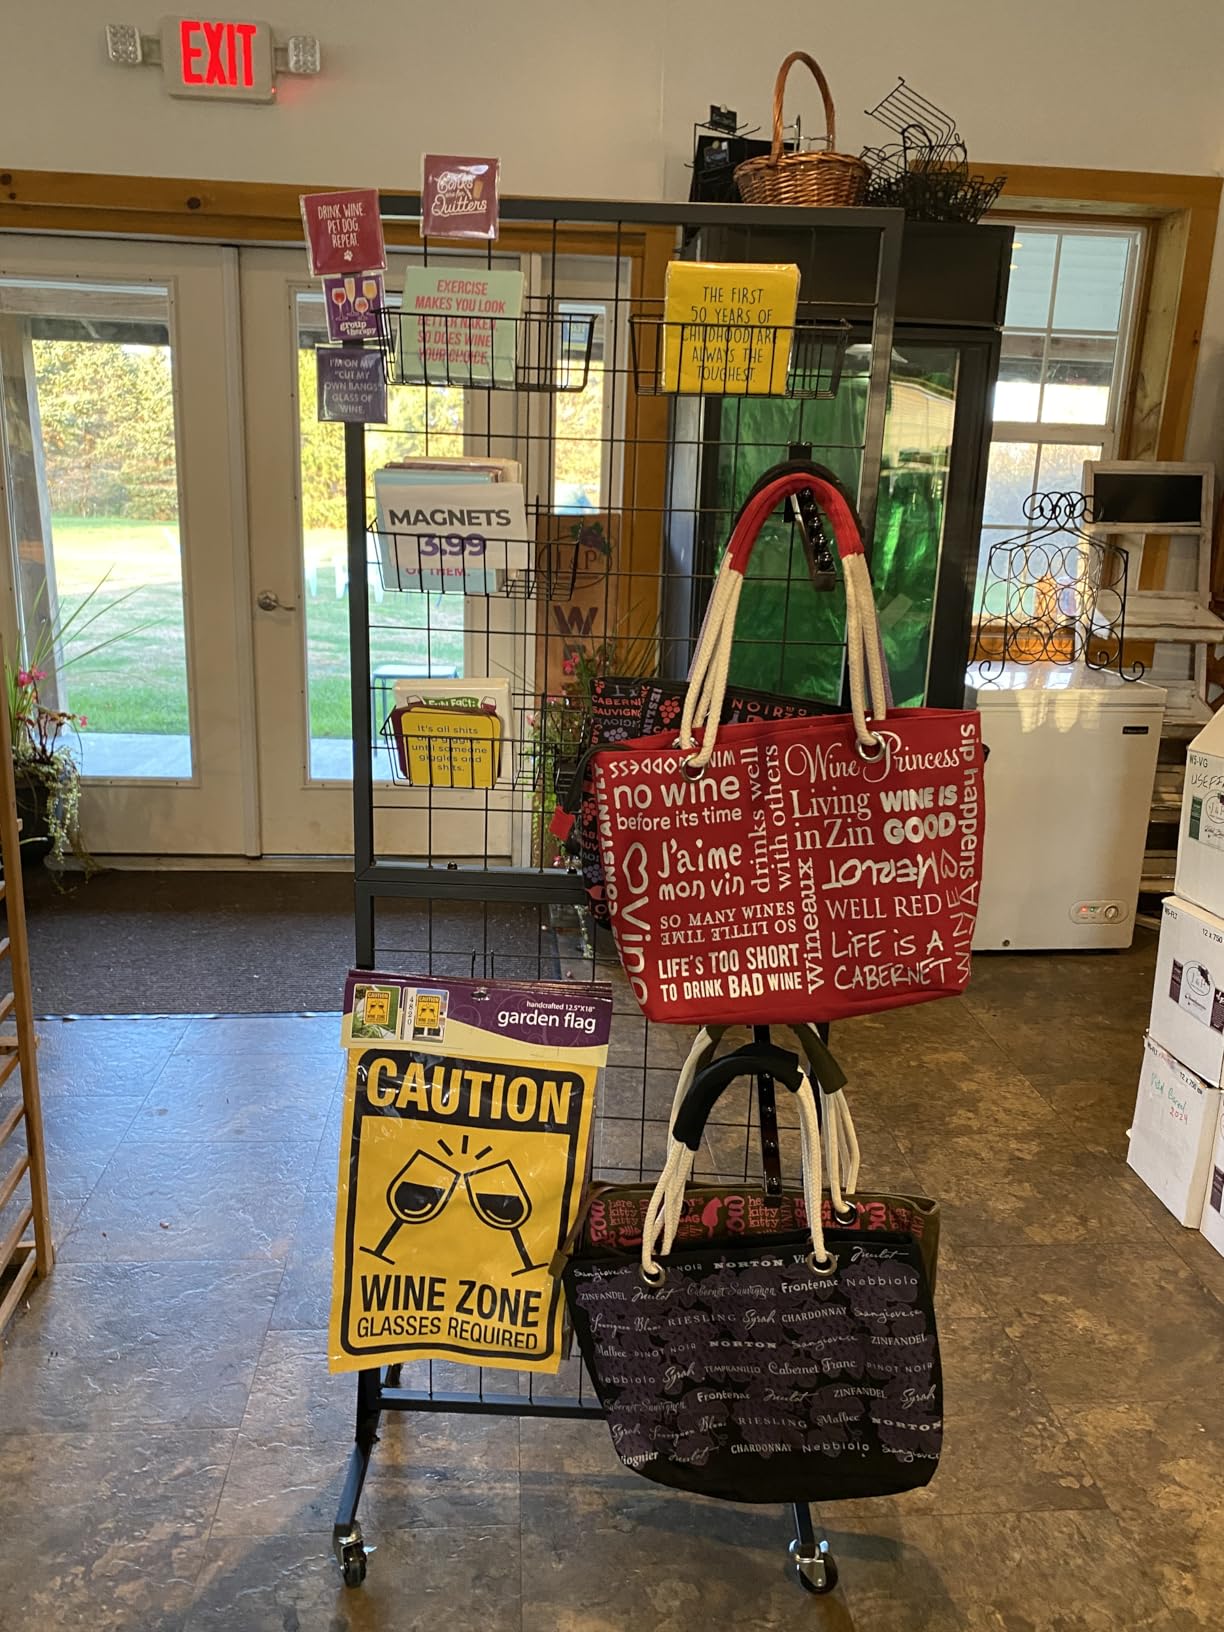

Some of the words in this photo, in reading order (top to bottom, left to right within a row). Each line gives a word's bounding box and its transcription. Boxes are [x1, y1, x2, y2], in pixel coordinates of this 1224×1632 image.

[180, 20, 256, 87] EXIT
[432, 195, 487, 217] Quitters
[327, 219, 341, 235] PET
[437, 279, 488, 296] EXERCISE
[703, 286, 724, 304] THE
[731, 287, 764, 304] FIRST
[416, 296, 452, 311] MAKES
[456, 298, 477, 312] YOU
[478, 300, 506, 314] LOOK
[691, 306, 707, 323] 50
[714, 308, 750, 324] YEARS
[758, 308, 774, 324] OF
[340, 320, 367, 332] group
[346, 327, 377, 336] therapy
[434, 332, 462, 345] DOES
[464, 333, 491, 348] WINE
[344, 359, 358, 368] ON
[360, 359, 374, 368] MY
[692, 347, 735, 363] ALWAYS
[744, 348, 764, 364] THE
[325, 382, 347, 391] OWN
[356, 371, 370, 379] MY
[332, 393, 359, 402] GLASS
[361, 393, 373, 402] OF
[388, 508, 512, 528] MAGNETS
[418, 533, 487, 556] 3.99
[436, 725, 450, 733] all
[454, 726, 478, 734] shits
[438, 746, 488, 754] someone
[959, 724, 980, 762] sip
[784, 743, 860, 784] Wine
[862, 730, 960, 783] Princess
[740, 746, 762, 801] well
[764, 744, 786, 827] others
[614, 784, 652, 809] no
[660, 775, 741, 808] wine
[790, 786, 872, 820] Living
[880, 787, 935, 813] WINE
[938, 784, 958, 807] IS
[617, 812, 671, 832] before
[676, 810, 699, 828] its
[702, 806, 742, 824] time
[883, 812, 957, 845] GOOD
[958, 768, 979, 880] happens
[594, 763, 618, 917] CONSTANTLY
[794, 822, 822, 850] in
[823, 818, 874, 848] Zin
[656, 838, 742, 878] J'aime
[748, 809, 770, 893] drinks
[768, 833, 792, 892] with
[822, 851, 939, 890] MERLOT
[658, 880, 706, 900] mon
[710, 872, 745, 897] vin
[660, 914, 681, 930] SO
[688, 908, 737, 927] MANY
[741, 901, 796, 920] WINES
[824, 898, 888, 920] WELL
[894, 894, 942, 918] RED
[660, 930, 706, 946] TIME
[711, 922, 768, 942] LITTLE
[774, 918, 797, 934] SO
[798, 857, 825, 994] wineaux
[926, 930, 944, 955] A
[658, 955, 704, 980] LIFE'S
[708, 949, 740, 974] TOO
[746, 943, 800, 971] SHORT
[834, 958, 952, 990] CABERNET
[660, 983, 678, 1002] TO
[683, 978, 724, 1000] DRINK
[728, 972, 764, 998] BAD
[766, 972, 802, 992] WINE
[526, 1000, 564, 1010] handcrafted
[498, 1009, 560, 1027] garden
[564, 1012, 596, 1034] flag
[366, 1057, 572, 1125] CAUTION
[1170, 1106, 1188, 1126] 2024
[713, 1259, 784, 1270] NORTON
[850, 1246, 910, 1262] Merlot
[360, 1274, 447, 1312] WINE
[455, 1280, 542, 1328] ZONE
[581, 1291, 628, 1300] ZINFANDEL
[632, 1286, 685, 1302] Merlot
[780, 1279, 840, 1294] Frontenac
[846, 1276, 918, 1287] Nebbiolo
[668, 1314, 736, 1327] RIESLING
[743, 1308, 776, 1330] Syrah
[781, 1307, 847, 1323] CHARDONNAY
[357, 1315, 442, 1338] GLASSES
[448, 1317, 538, 1350] REQUIRED
[670, 1342, 696, 1353] NOIR
[708, 1340, 777, 1350] NORTON
[870, 1333, 928, 1346] ZINFANDEL
[662, 1362, 696, 1391] Syrah
[704, 1364, 761, 1374] TEMPRANILLO
[768, 1361, 820, 1376] Cabernet
[821, 1357, 858, 1372] Franc
[866, 1362, 898, 1373] PINOT
[905, 1362, 933, 1374] NOIR
[697, 1390, 752, 1402] Frontenac
[762, 1387, 820, 1402] Merlot
[833, 1387, 888, 1398] ZINFANDEL
[900, 1384, 937, 1410] Syrah
[612, 1424, 641, 1446] Syrah
[738, 1416, 808, 1430] RIESLING
[816, 1410, 860, 1427] Malbec
[872, 1417, 942, 1432] NORTON
[731, 1443, 792, 1454] CHARDONNAY
[802, 1442, 870, 1453] Nebbiolo
